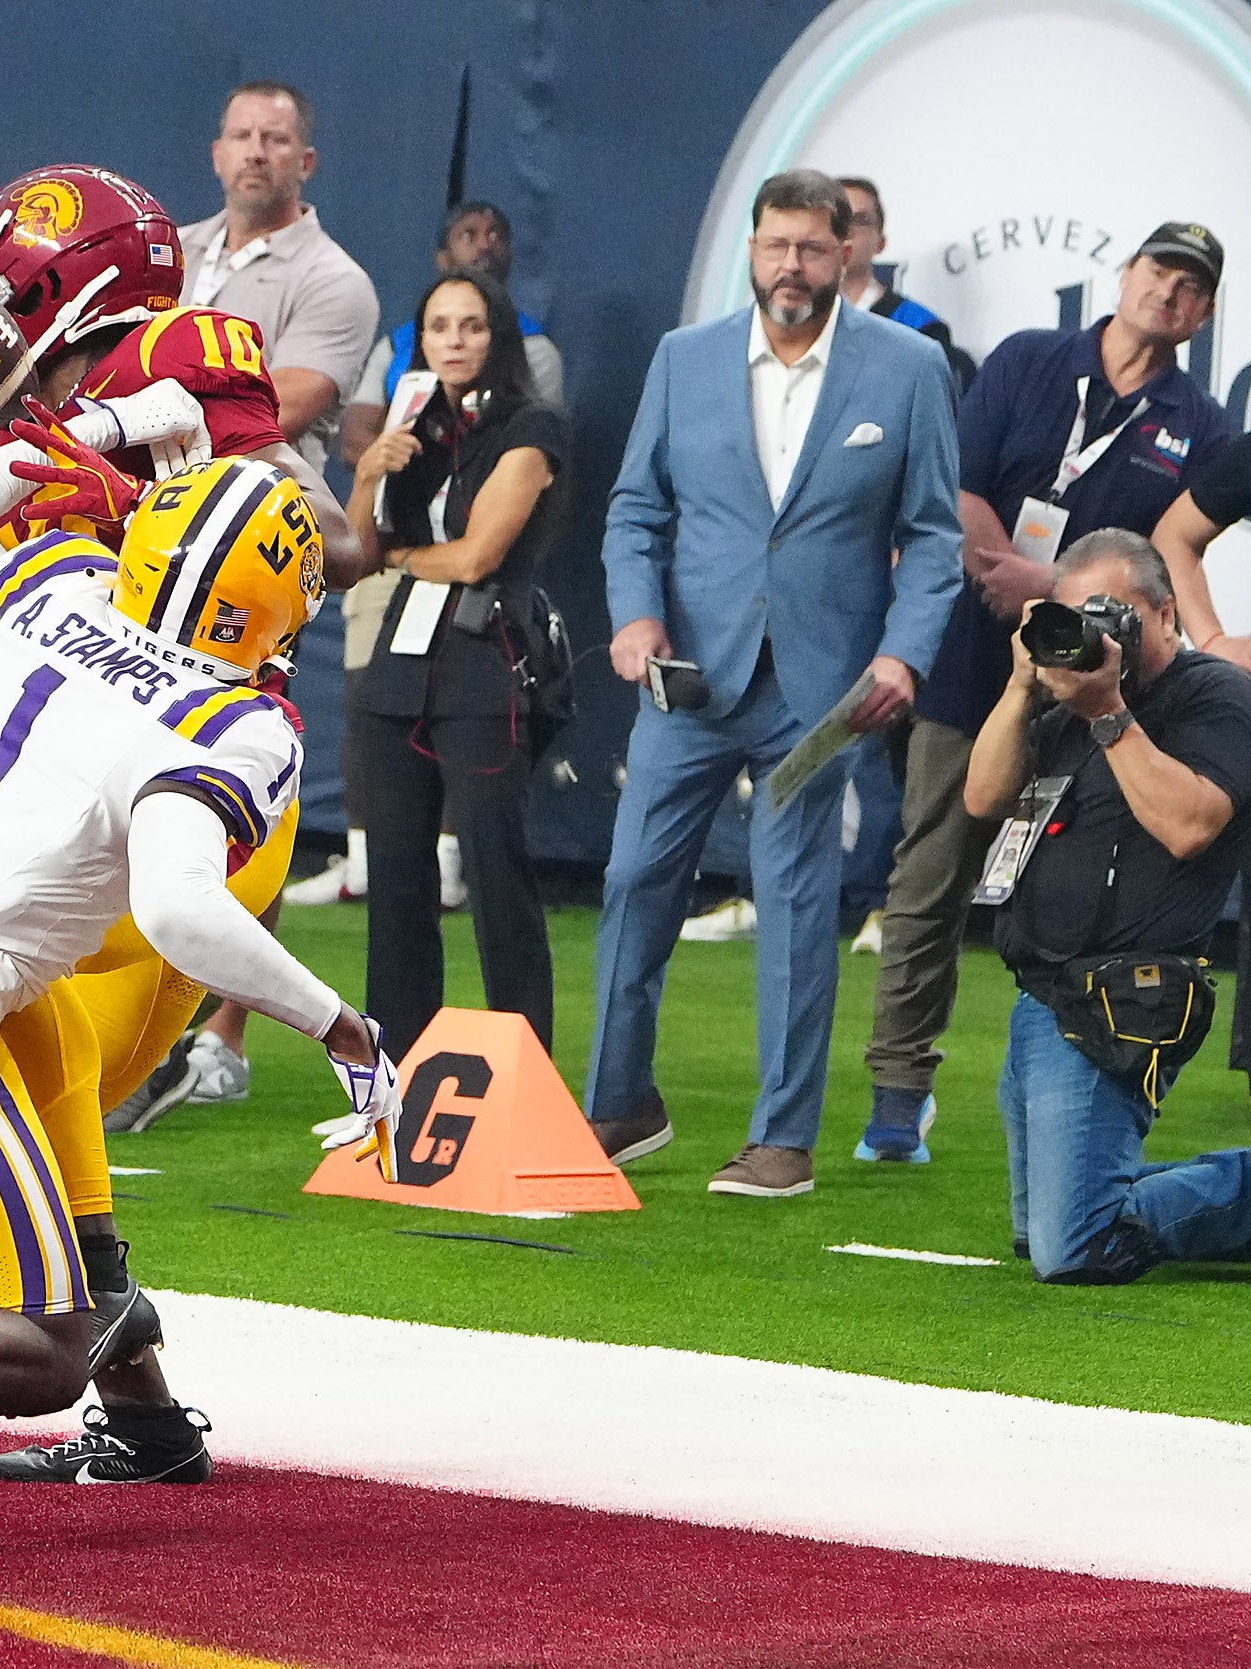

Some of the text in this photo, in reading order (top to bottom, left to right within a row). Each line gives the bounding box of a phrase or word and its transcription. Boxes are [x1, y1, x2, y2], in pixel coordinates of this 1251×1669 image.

[943, 214, 1127, 276] CERVEZ
[147, 296, 171, 309] FIGHT
[193, 315, 262, 376] 10
[11, 593, 178, 705] A. STAMPS
[122, 625, 216, 676] TIGERS
[379, 1051, 494, 1188] G
